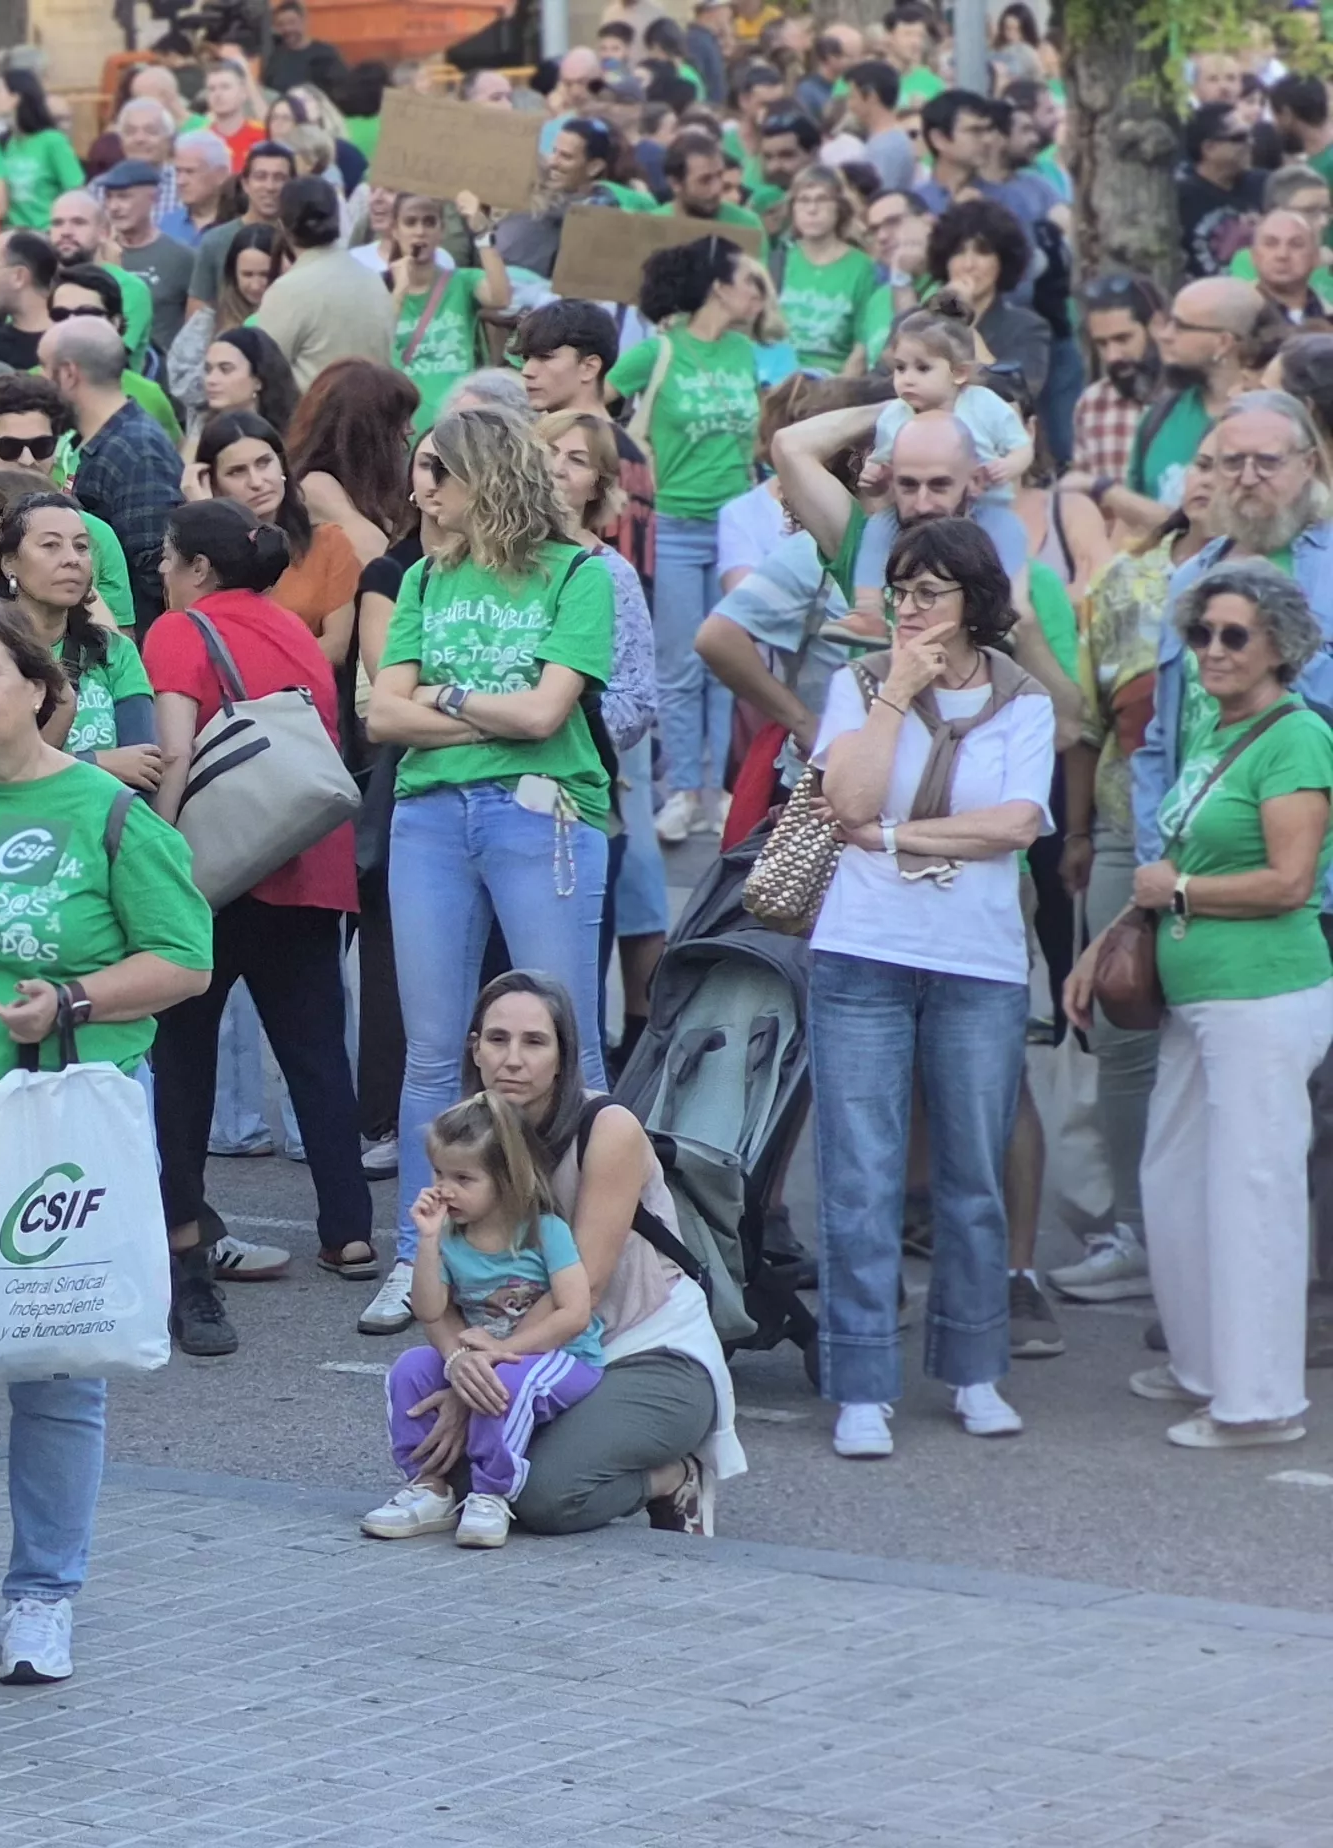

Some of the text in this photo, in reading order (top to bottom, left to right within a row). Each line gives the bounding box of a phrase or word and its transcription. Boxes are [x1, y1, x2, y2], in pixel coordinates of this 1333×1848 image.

[6, 842, 55, 861] CSIF
[20, 1187, 106, 1233] CSIF
[5, 1274, 108, 1295] Central Sindical
[9, 1297, 105, 1318] Independiente
[11, 1323, 29, 1339] de
[32, 1318, 117, 1339] funcionarios
